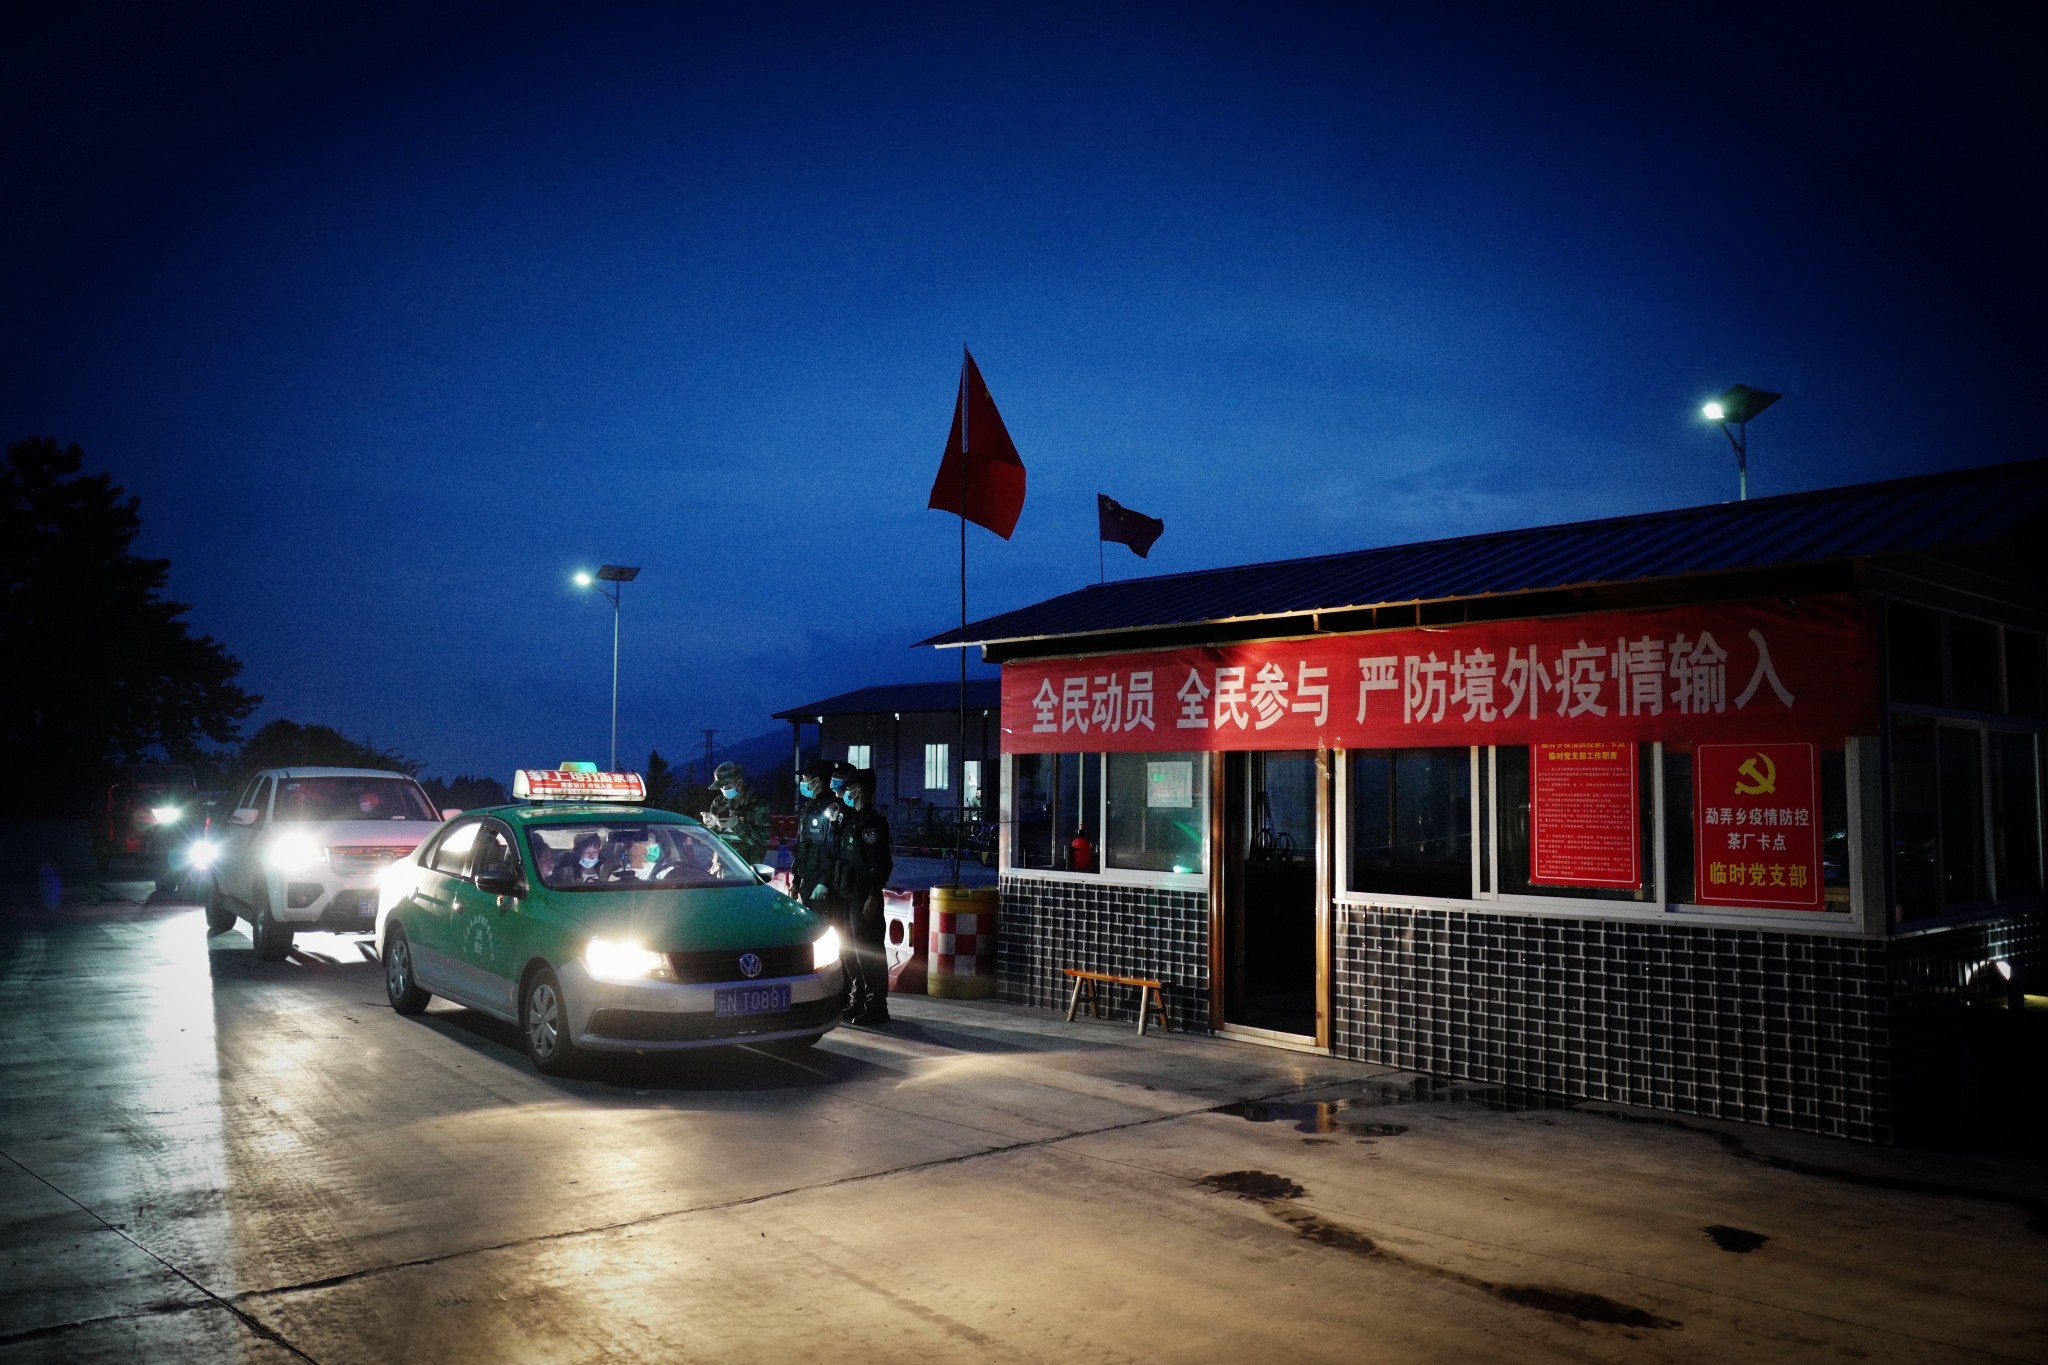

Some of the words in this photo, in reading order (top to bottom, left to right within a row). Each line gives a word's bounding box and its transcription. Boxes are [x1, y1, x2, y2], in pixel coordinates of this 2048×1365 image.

[1031, 671, 1156, 735] 全民动员
[1176, 661, 1330, 732] 全民参与
[1356, 628, 1795, 726] 严防境外疫情输入
[1548, 752, 1618, 761] 临时党支部工作职责
[1705, 807, 1810, 827] 勐弄乡疫情防控
[1727, 832, 1787, 851] 茶厂卡点
[1709, 861, 1808, 889] 临时党支部
